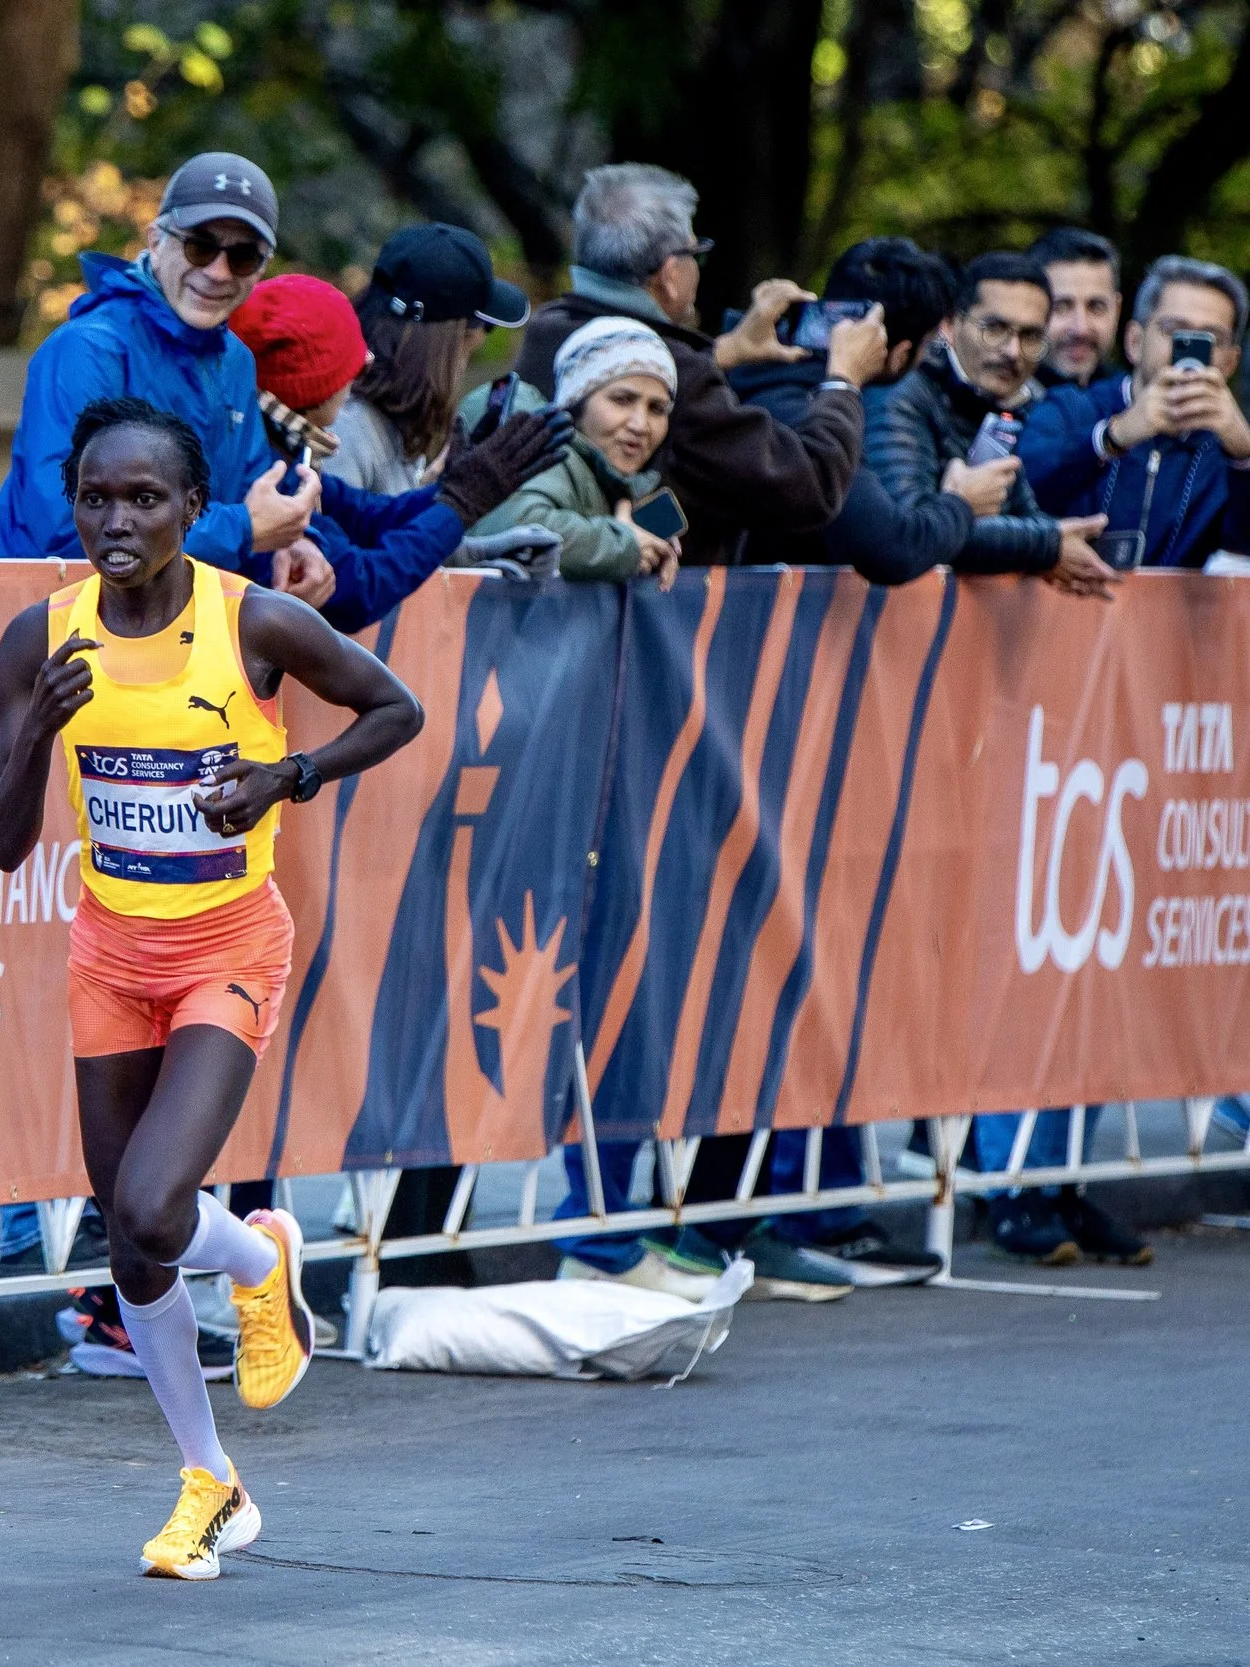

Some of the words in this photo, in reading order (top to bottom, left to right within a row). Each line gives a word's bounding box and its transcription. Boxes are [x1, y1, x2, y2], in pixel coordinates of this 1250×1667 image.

[1162, 702, 1233, 772] TATA
[131, 753, 153, 762] TATA
[131, 760, 184, 771] CONSULTANCY
[198, 764, 225, 776] TAT
[131, 769, 165, 779] SERVICES
[1016, 703, 1148, 974] tcs
[1157, 799, 1250, 870] CONSUL
